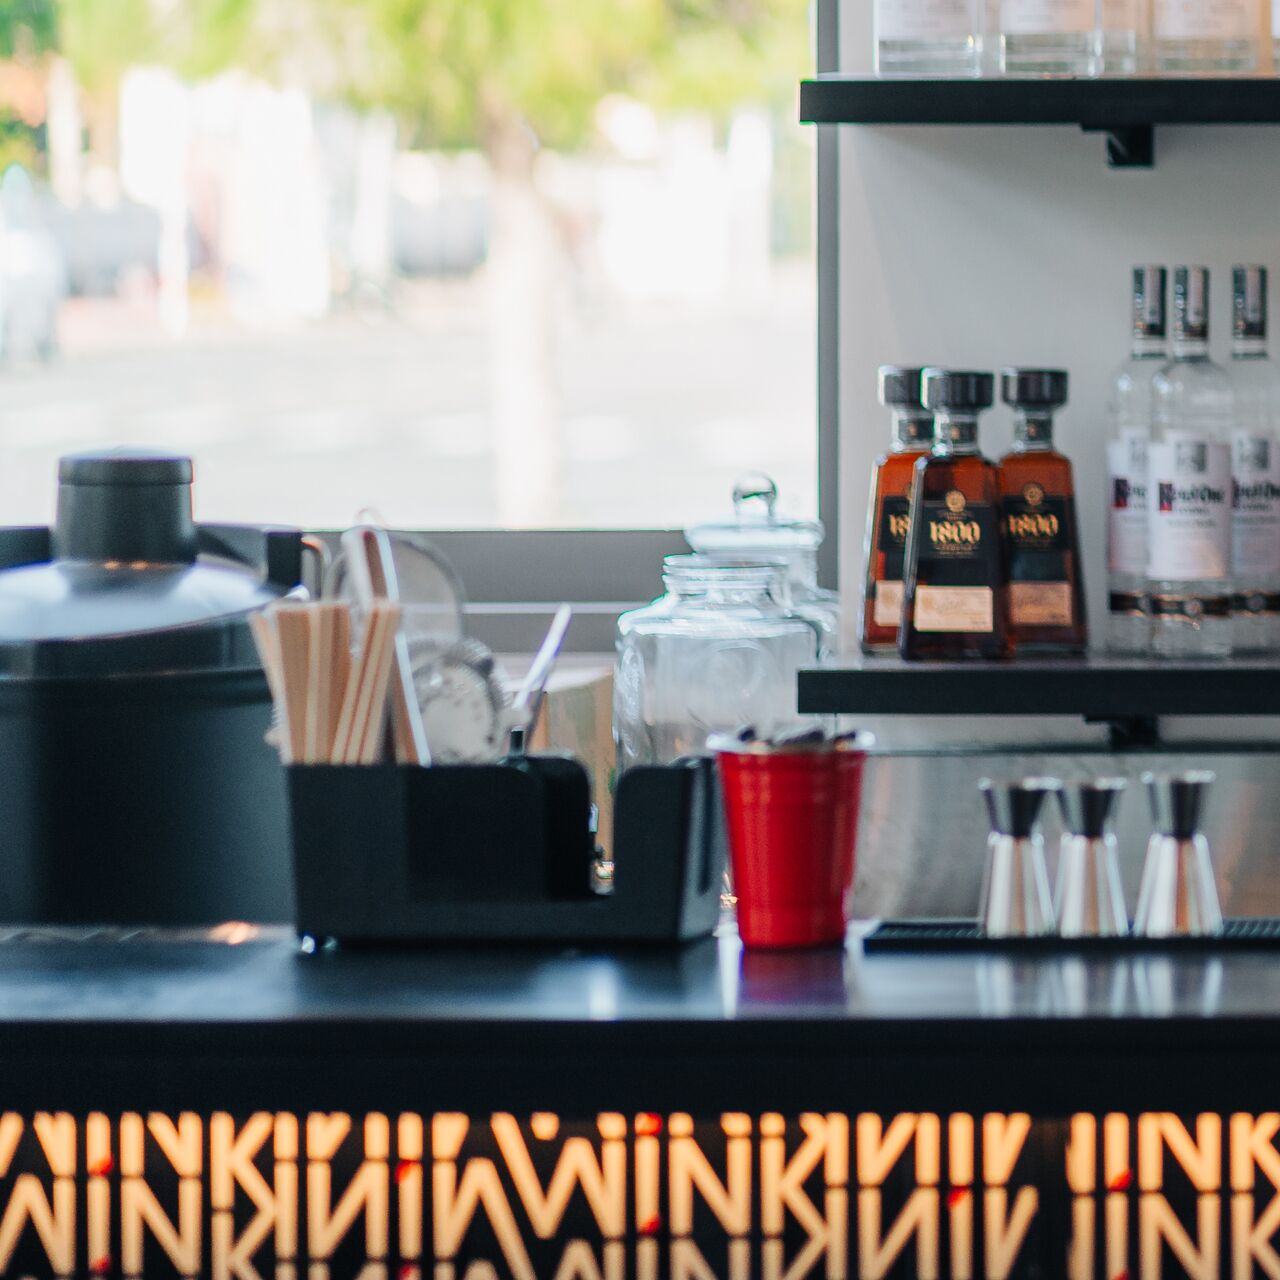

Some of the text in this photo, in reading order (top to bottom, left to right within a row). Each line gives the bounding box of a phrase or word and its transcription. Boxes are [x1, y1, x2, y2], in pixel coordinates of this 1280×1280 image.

[929, 520, 981, 545] 1800
[1007, 513, 1059, 538] 1800
[492, 1117, 832, 1238] WINK
